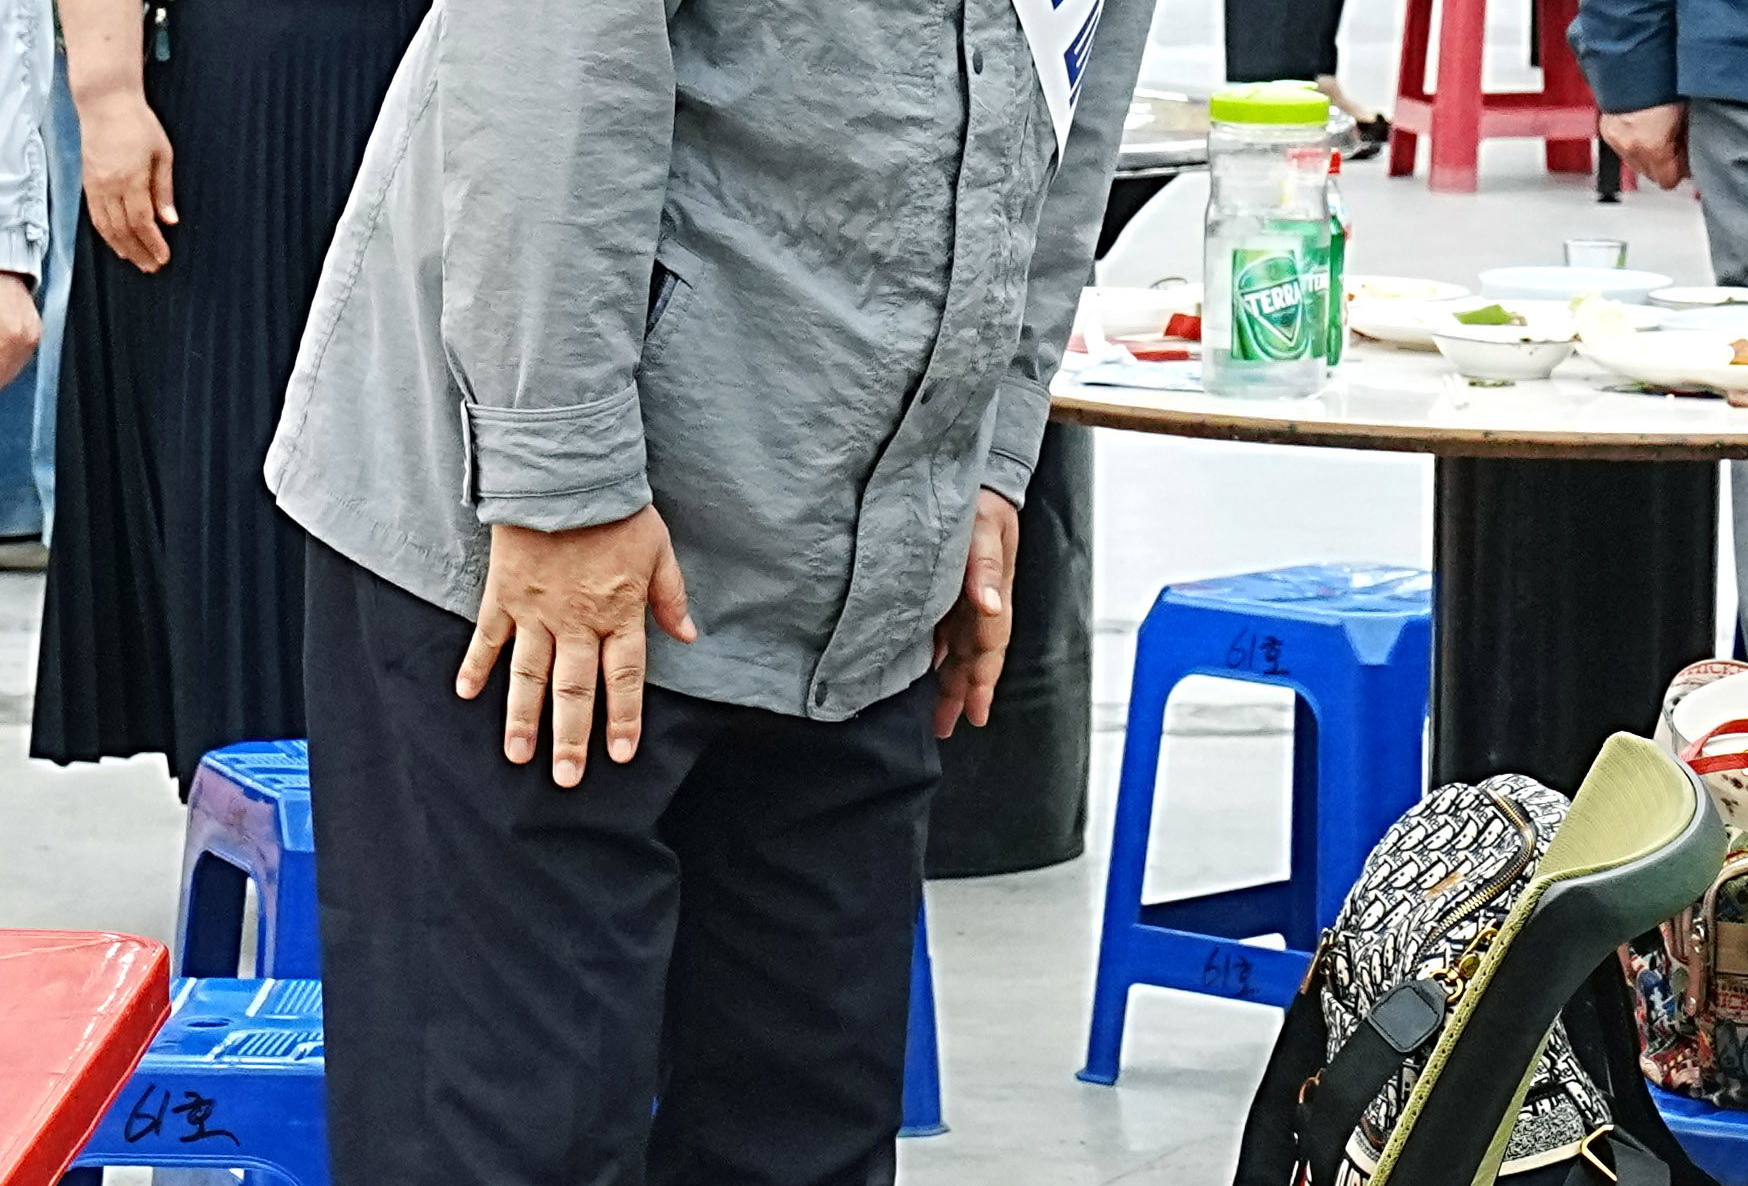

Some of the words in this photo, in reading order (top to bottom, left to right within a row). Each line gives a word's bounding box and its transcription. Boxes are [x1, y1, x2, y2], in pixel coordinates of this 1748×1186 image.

[1225, 627, 1292, 676] 61호
[1203, 944, 1257, 997] 61호
[124, 1083, 241, 1147] 61호
